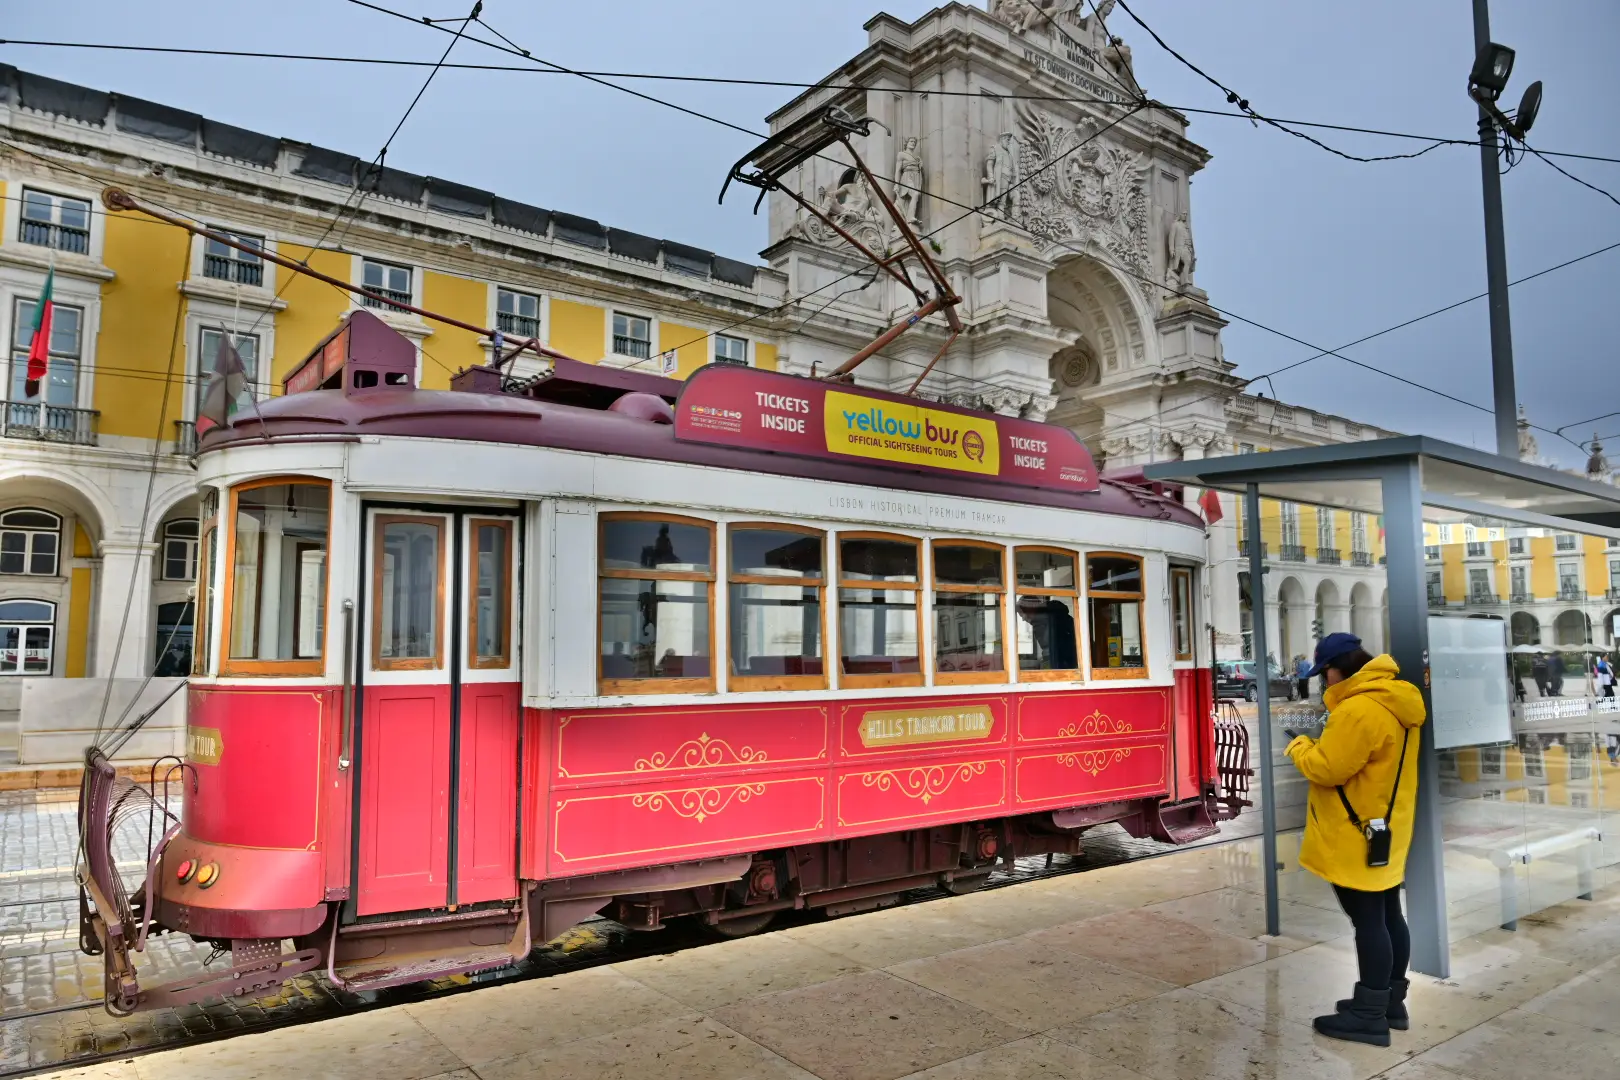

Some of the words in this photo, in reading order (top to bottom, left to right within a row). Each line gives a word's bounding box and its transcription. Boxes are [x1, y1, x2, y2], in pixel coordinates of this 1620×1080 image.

[755, 391, 809, 414] TICKETS
[761, 413, 805, 434] INSIDE
[925, 418, 959, 445] bus
[848, 434, 882, 448] OFFICIAL
[884, 439, 932, 455] SIGHTSEEING
[934, 447, 958, 459] TOURS
[1009, 436, 1048, 453] TICKETS
[1014, 454, 1046, 470] INSIDE
[829, 496, 864, 509] LISBON
[870, 501, 922, 516] HISTORICAL
[929, 506, 966, 520] PREMIUM
[972, 511, 1006, 525] TRAMCAR
[868, 718, 904, 739] HILLS
[907, 715, 955, 736] TRAMCAR
[957, 712, 986, 732] TOUR
[196, 735, 216, 757] TOUR
